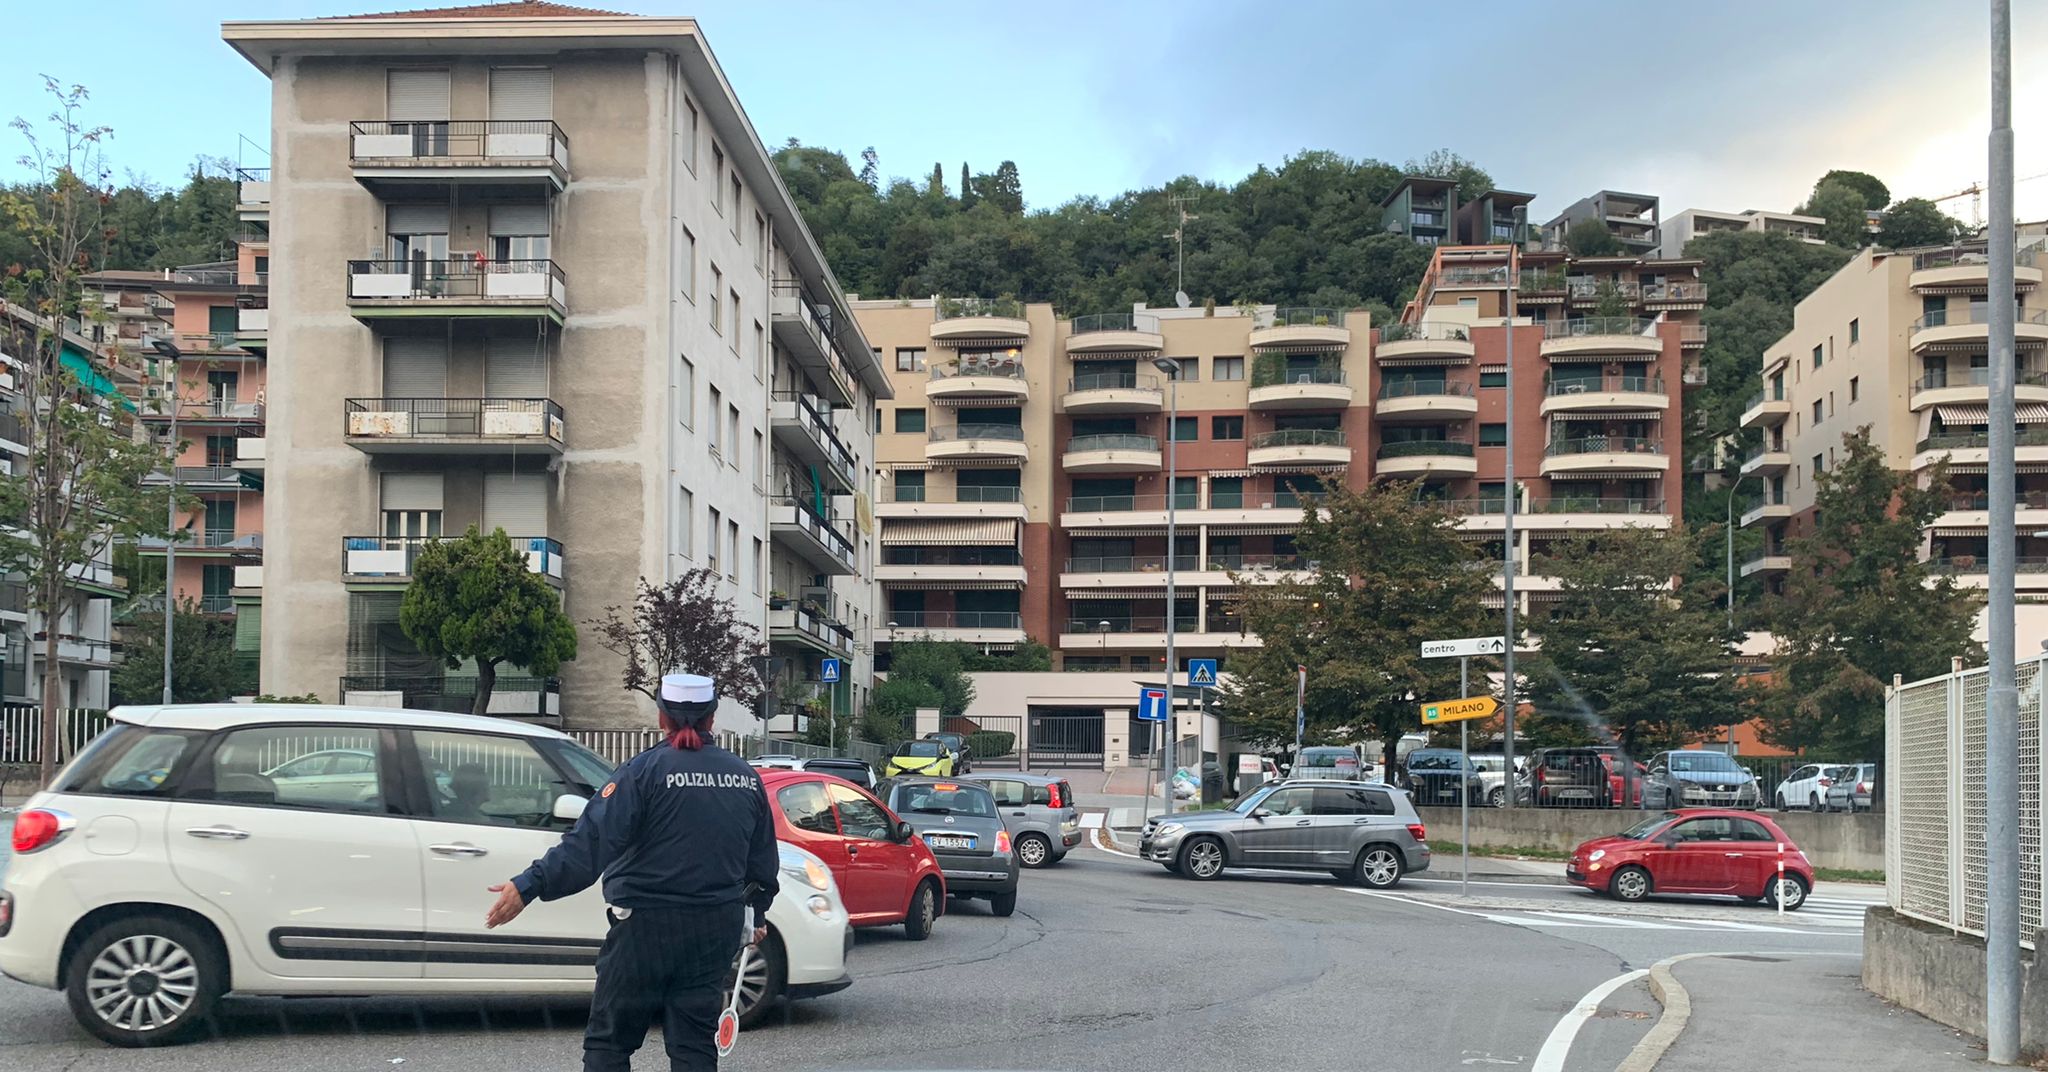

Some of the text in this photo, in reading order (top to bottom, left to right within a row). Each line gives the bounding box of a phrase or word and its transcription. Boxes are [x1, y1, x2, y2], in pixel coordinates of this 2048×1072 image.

[1423, 644, 1456, 654] centro
[1443, 702, 1485, 716] MILANO
[666, 772, 758, 791] POLIZIA LOCALE
